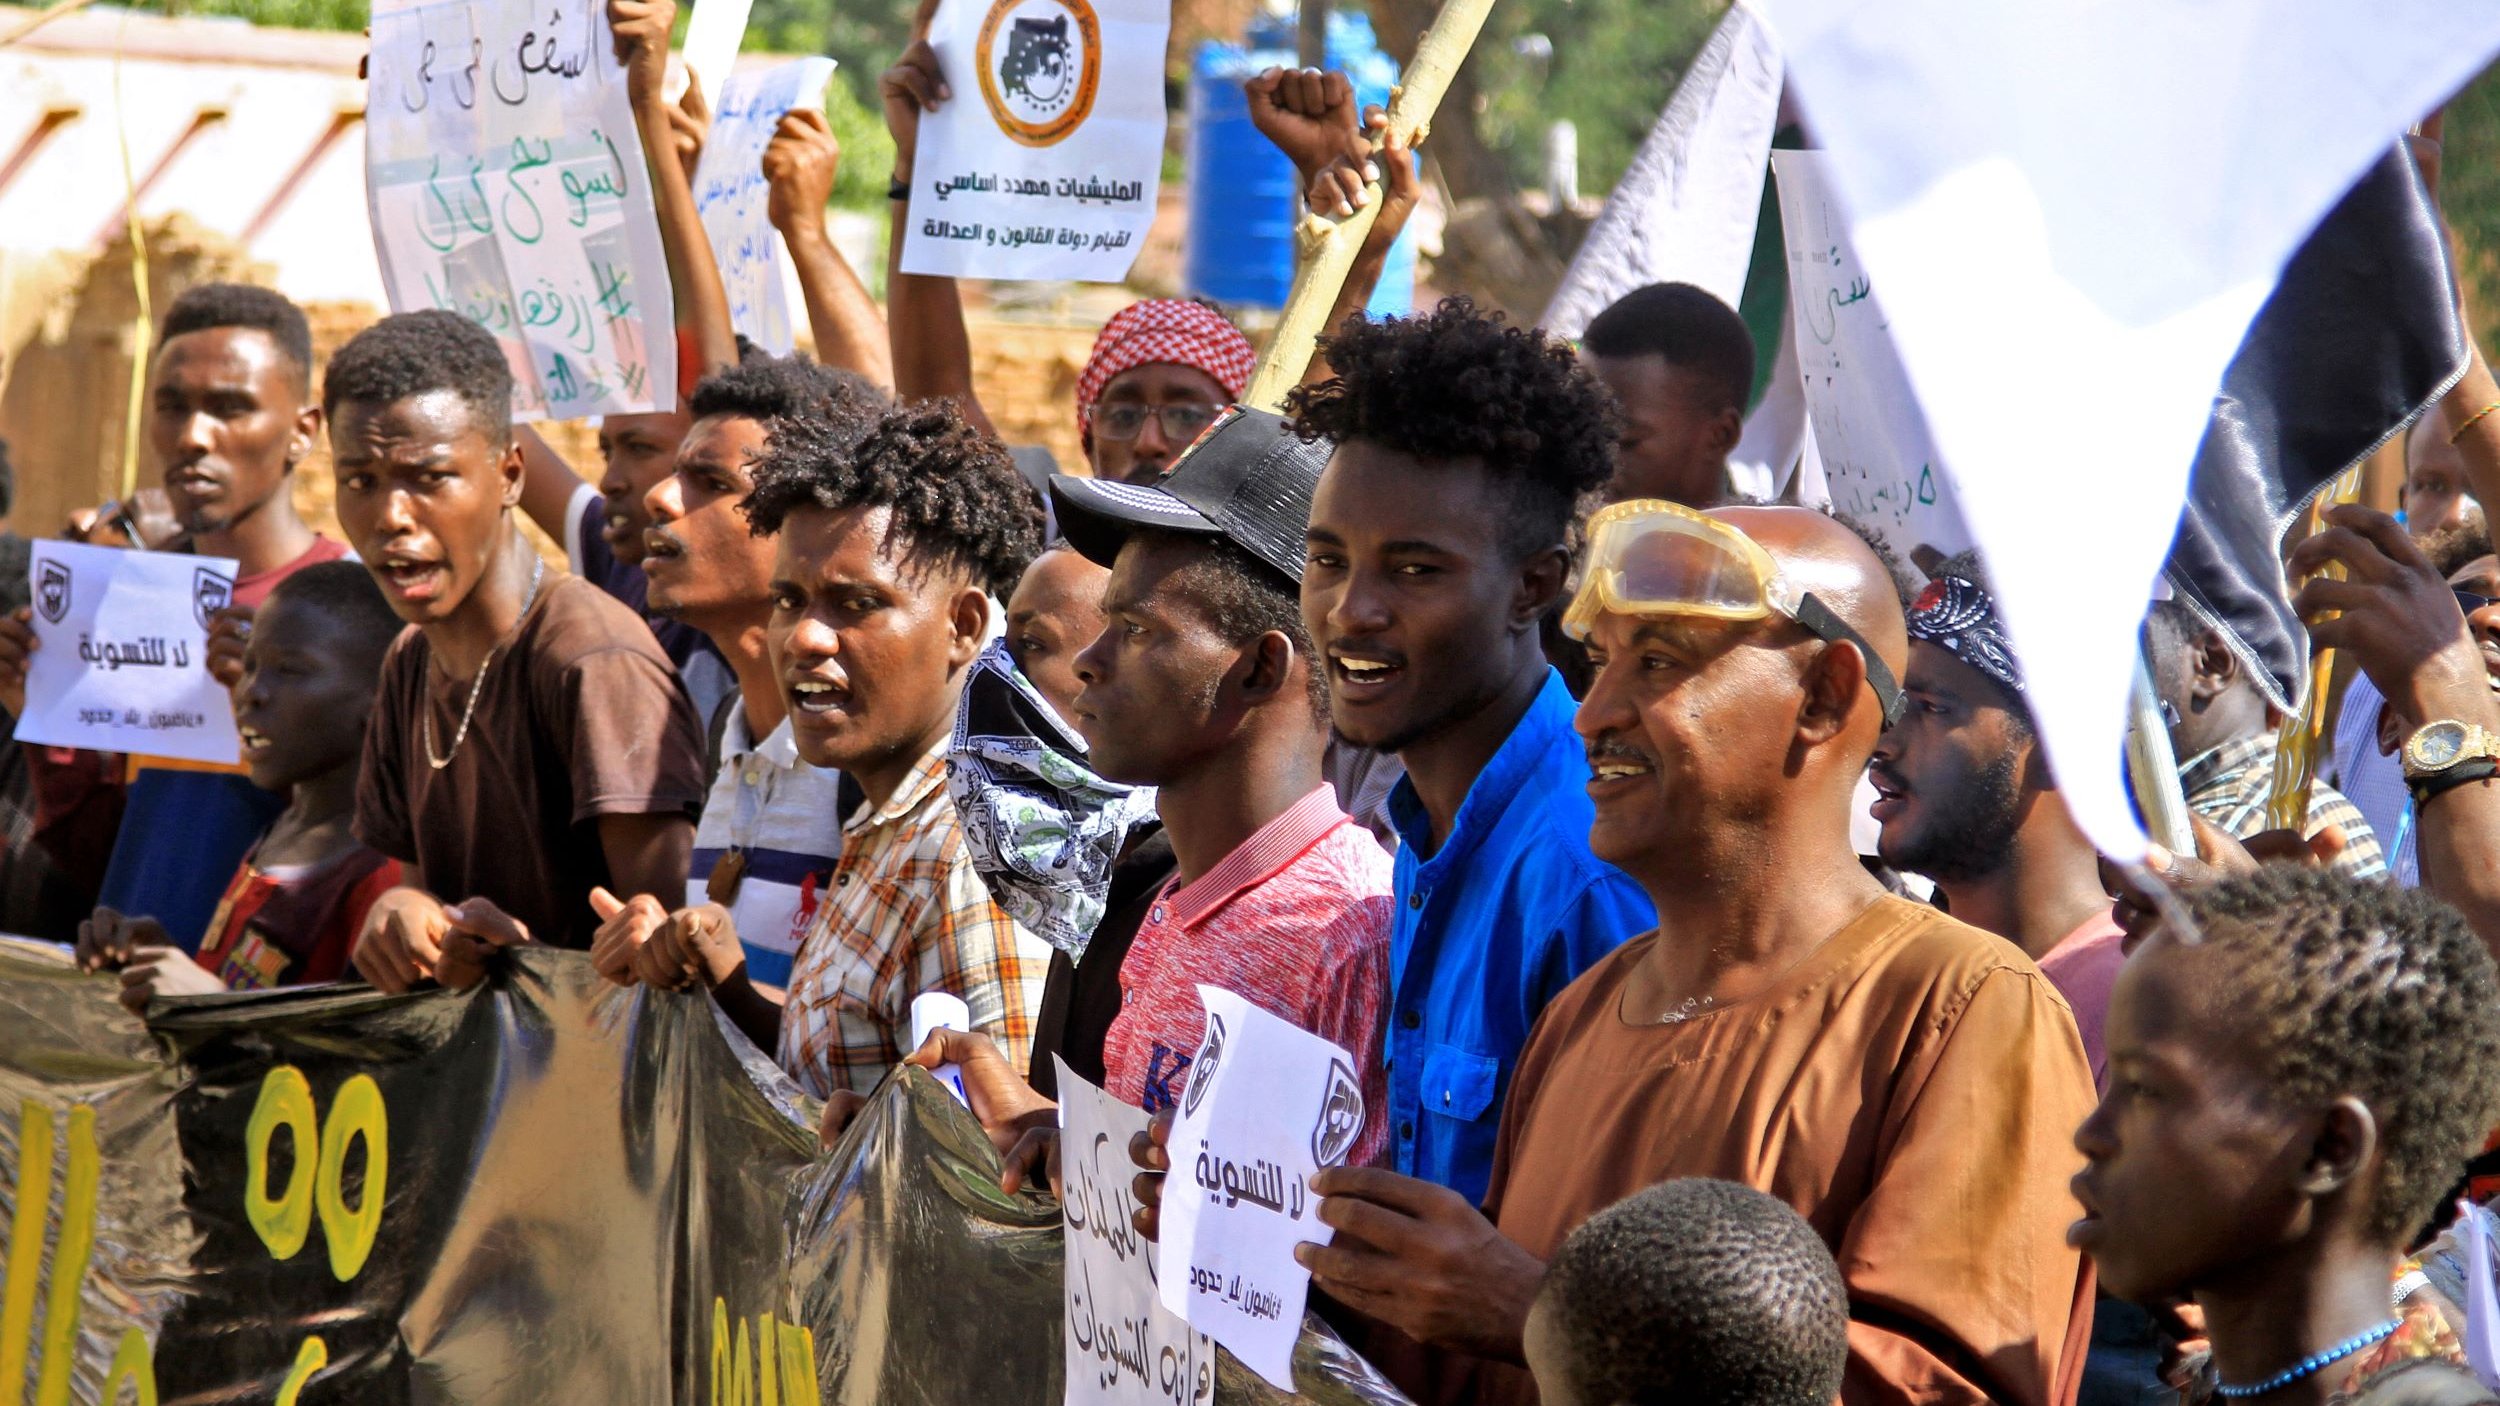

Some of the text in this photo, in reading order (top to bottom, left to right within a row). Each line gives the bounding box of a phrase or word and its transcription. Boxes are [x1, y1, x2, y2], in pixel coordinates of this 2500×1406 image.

[1004, 179, 1051, 196] مهدد
[1056, 175, 1143, 205] المليشيات
[923, 218, 1131, 252] لقيام دولة القانون و العدالة
[79, 631, 189, 671] لا للتسوية
[1143, 1041, 1192, 1115] K
[1196, 1139, 1305, 1221] لا للتسوية
